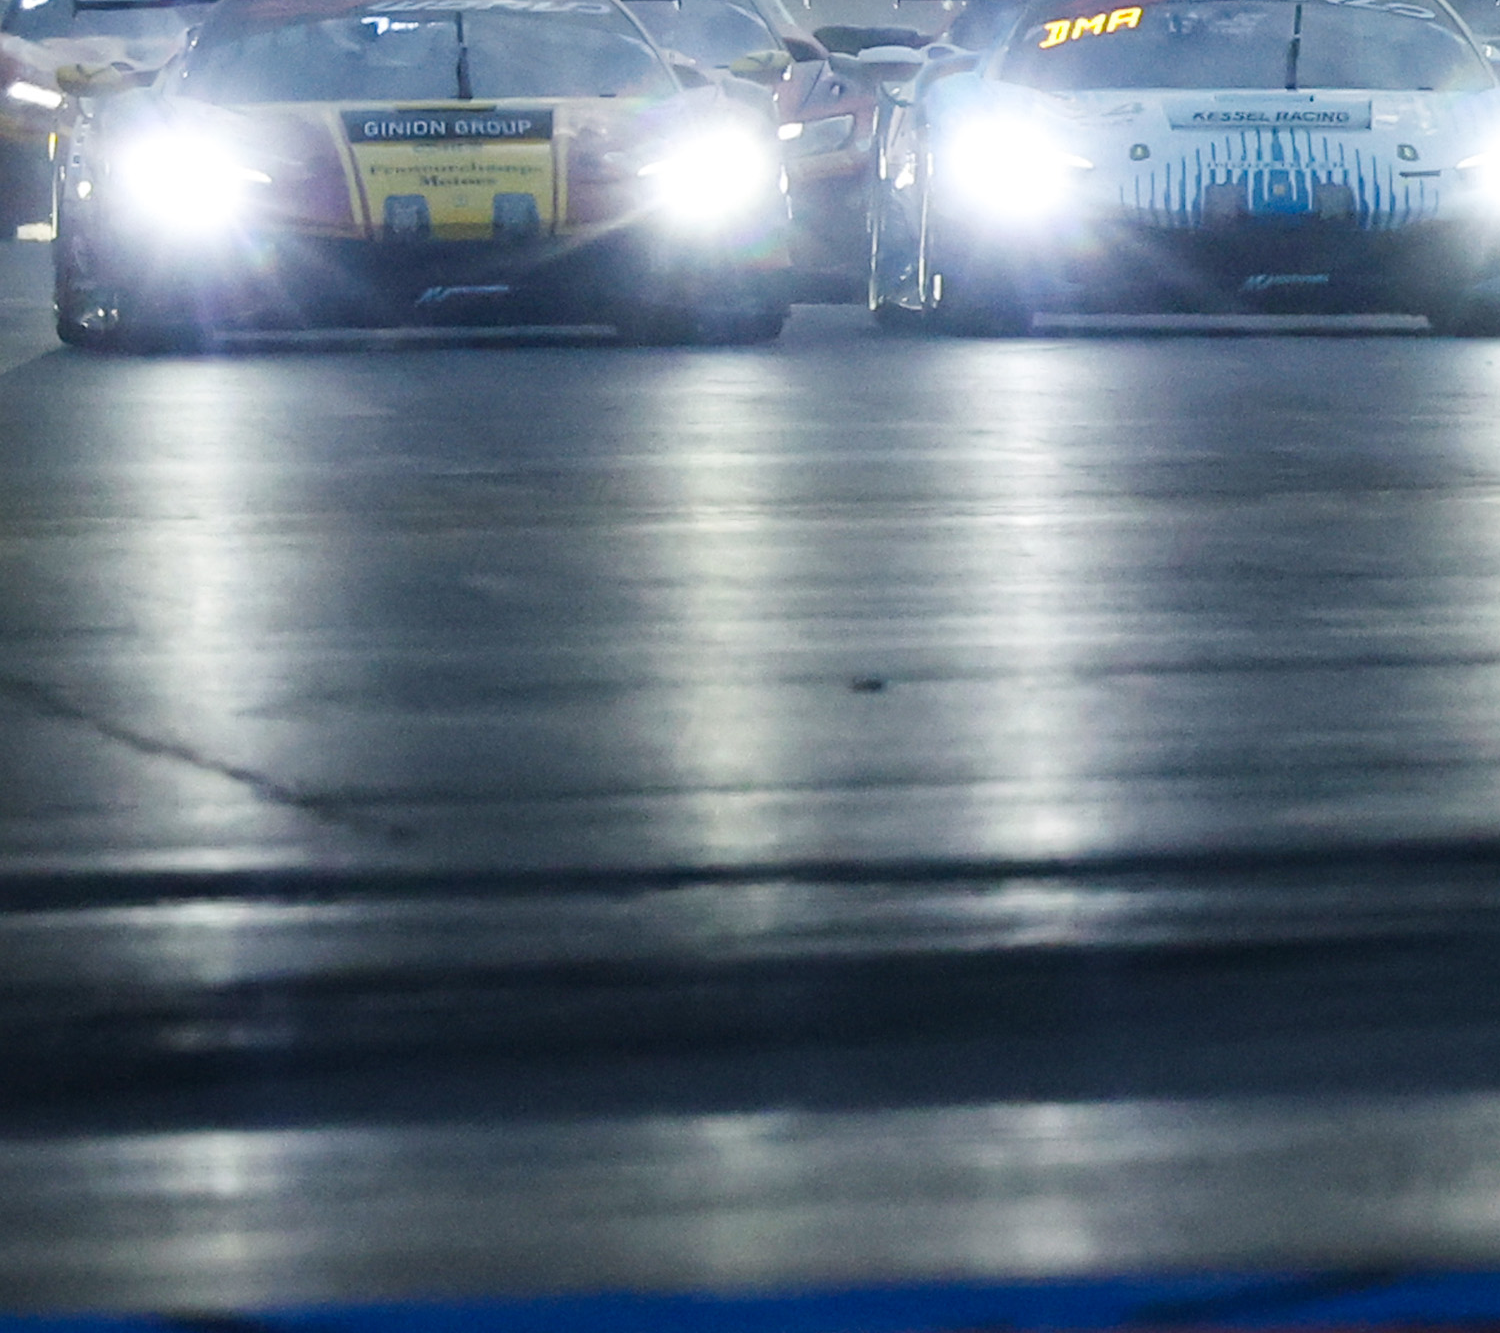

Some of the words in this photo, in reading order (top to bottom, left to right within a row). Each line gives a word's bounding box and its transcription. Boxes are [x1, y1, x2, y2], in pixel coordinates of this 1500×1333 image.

[1038, 5, 1144, 50] DMA
[1275, 111, 1350, 123] RACING
[363, 120, 447, 137] GINION
[454, 119, 532, 136] GROUP
